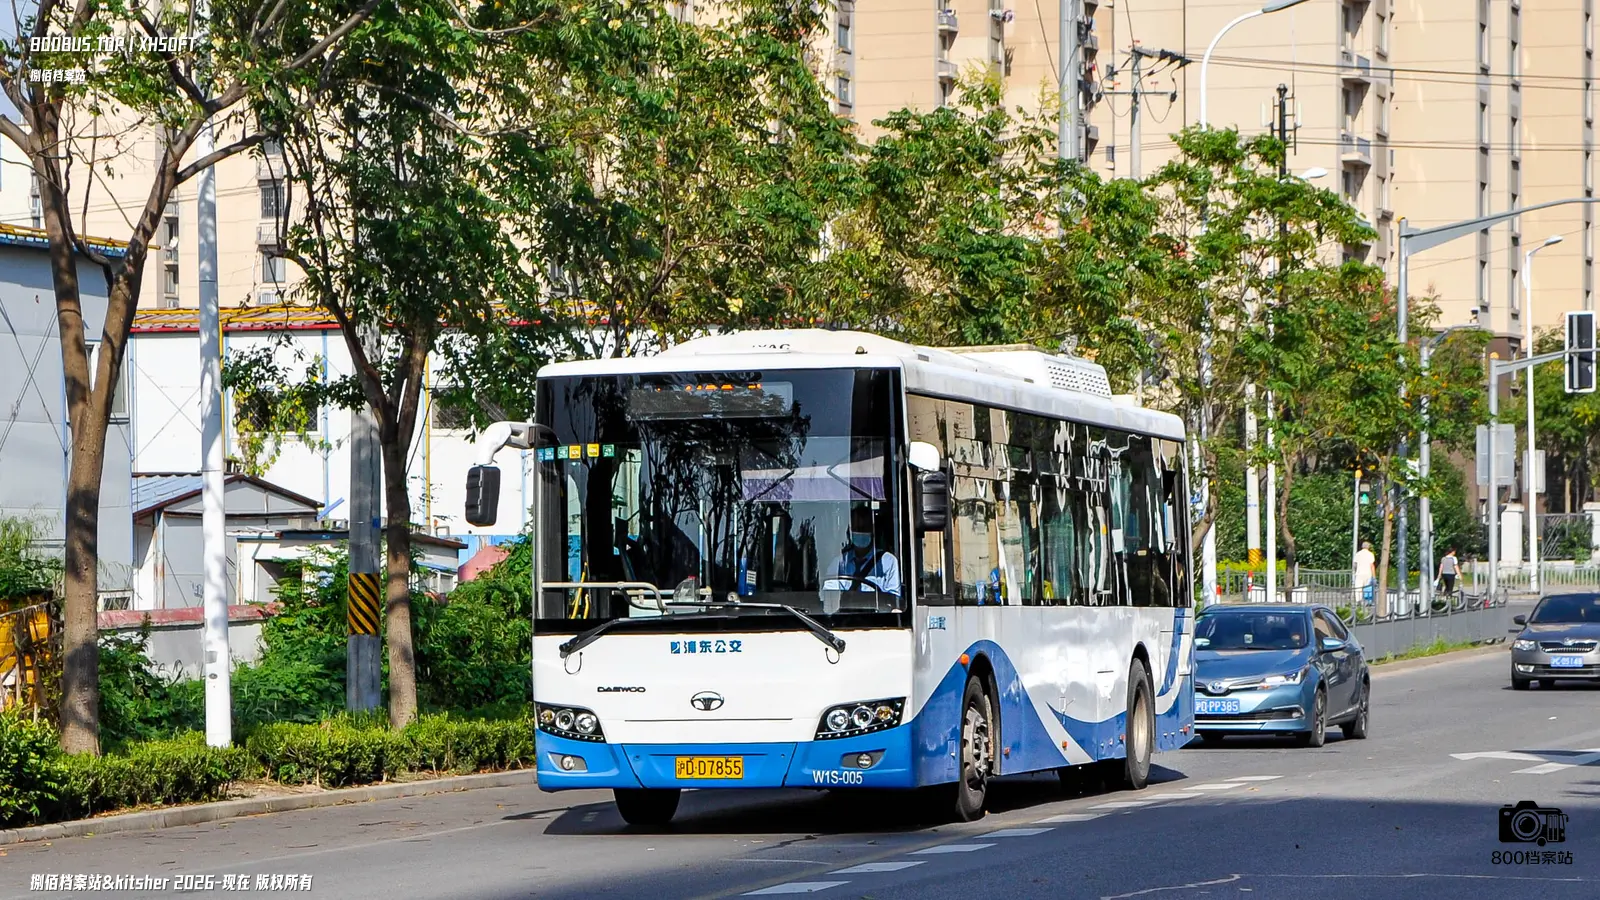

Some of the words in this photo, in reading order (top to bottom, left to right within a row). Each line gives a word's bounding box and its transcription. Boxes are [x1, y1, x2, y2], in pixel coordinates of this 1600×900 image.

[683, 640, 742, 654] 浦东公交
[812, 770, 863, 784] W1S-005
